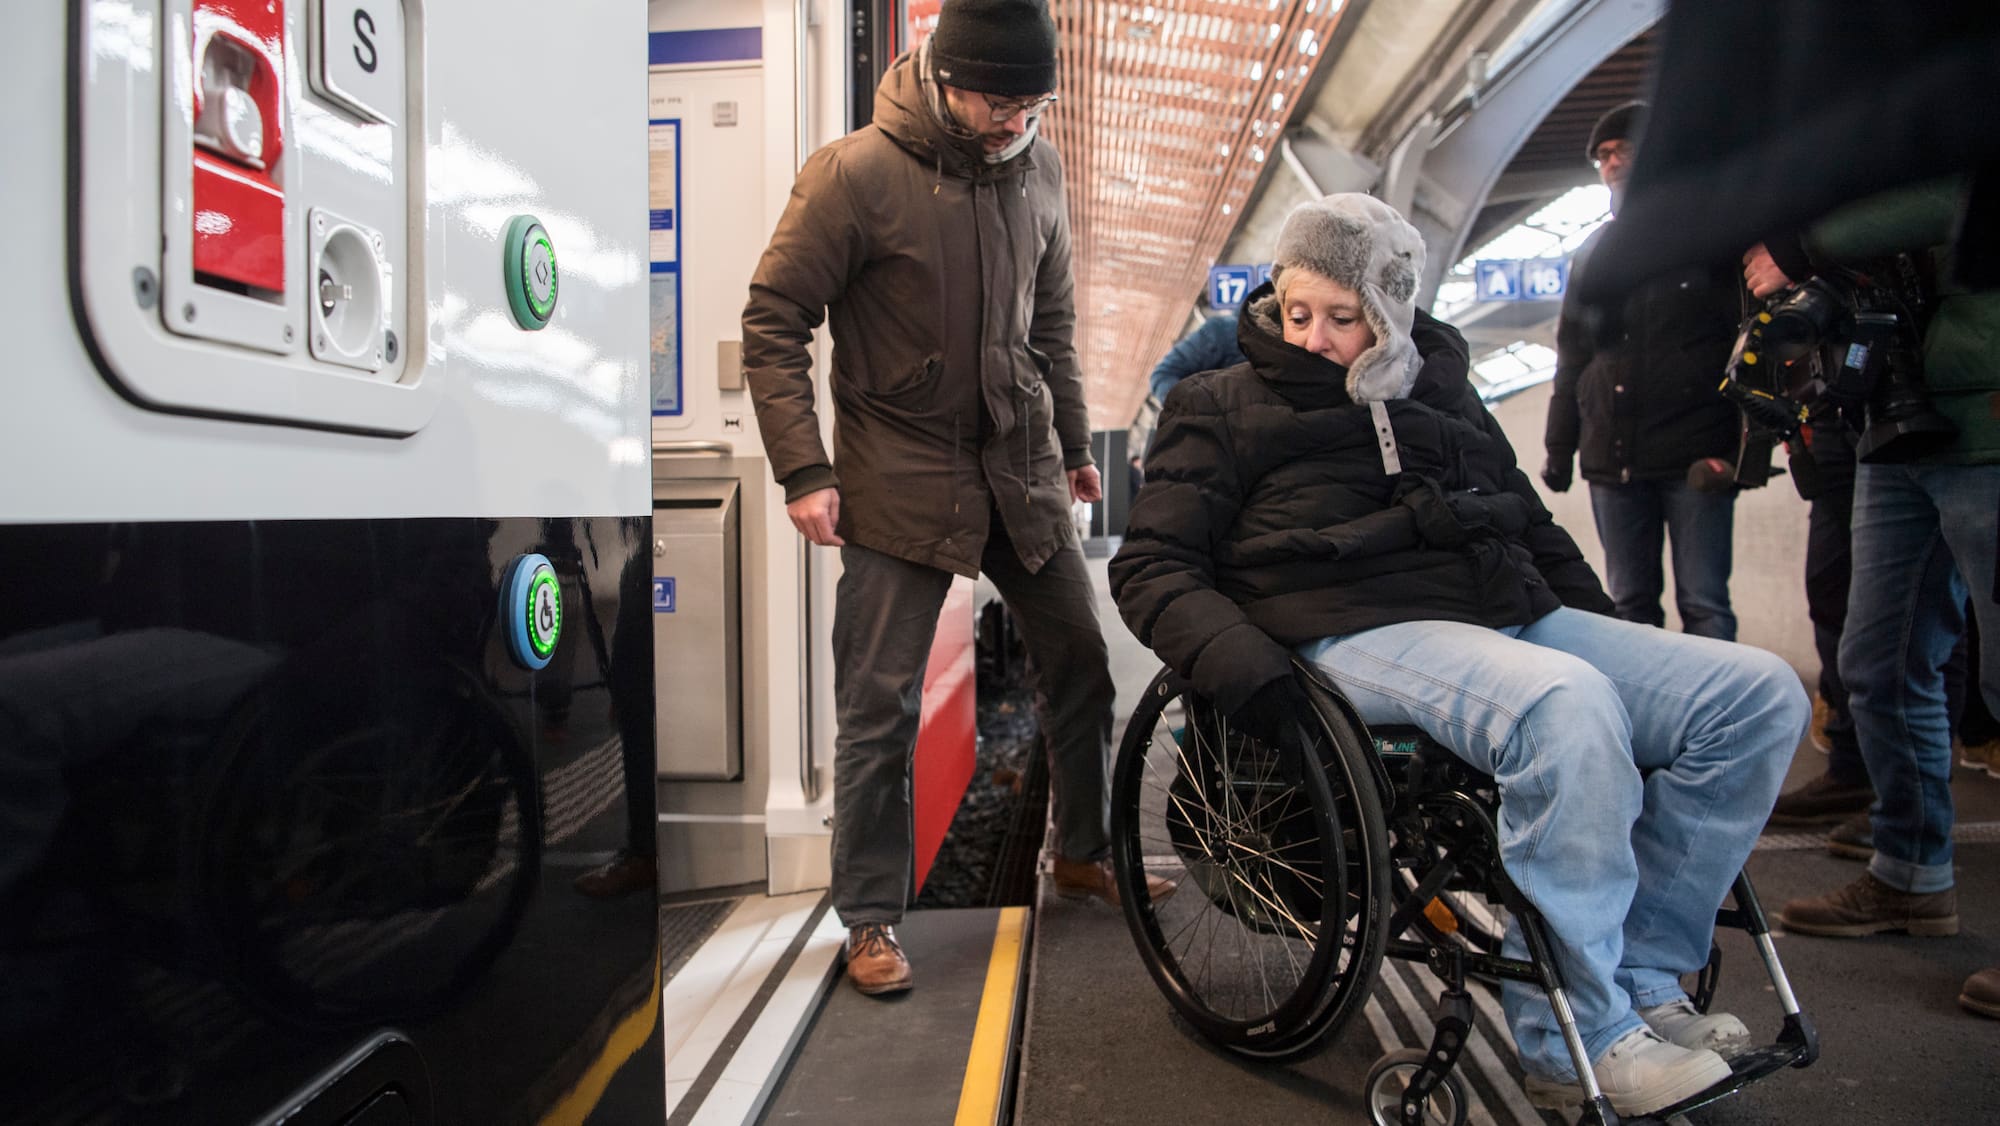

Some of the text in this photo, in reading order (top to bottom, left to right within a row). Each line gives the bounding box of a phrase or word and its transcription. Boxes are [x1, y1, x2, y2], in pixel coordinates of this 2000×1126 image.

[353, 8, 377, 74] S
[1218, 278, 1247, 304] 17
[1488, 268, 1509, 295] A
